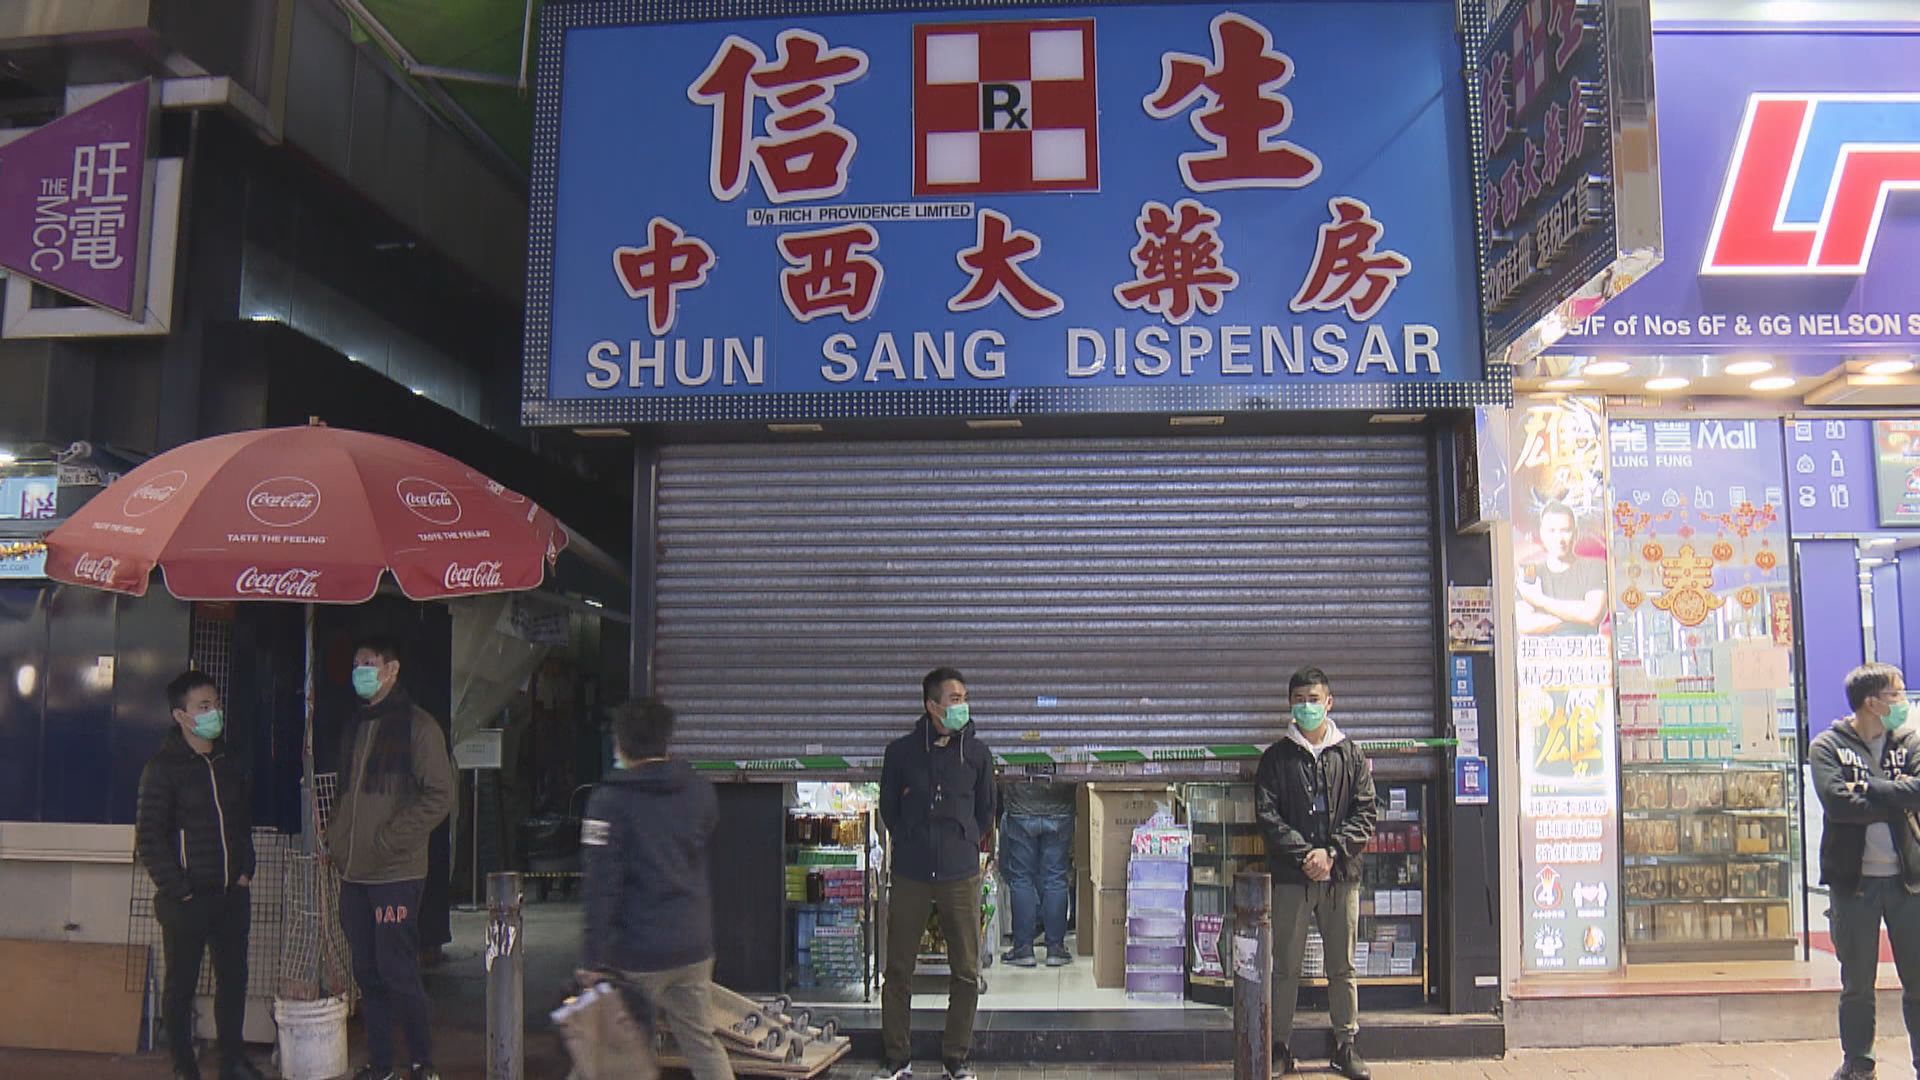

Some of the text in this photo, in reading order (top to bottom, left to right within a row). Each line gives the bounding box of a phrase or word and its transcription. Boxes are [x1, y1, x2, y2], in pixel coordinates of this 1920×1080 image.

[688, 12, 1322, 204] 信 生
[69, 142, 130, 269] 旺電
[779, 207, 812, 222] RICH
[819, 205, 910, 220] PROVIDENCE
[915, 204, 970, 218] LIMITED
[30, 178, 69, 272] THE MCC
[613, 197, 1412, 336] 中西大藥房
[1613, 315, 1638, 336] of
[1644, 315, 1691, 336] Nos
[1697, 315, 1727, 336] 6F
[1734, 315, 1753, 336] &
[1758, 315, 1792, 336] 6G
[1799, 313, 1901, 336] NELSON
[585, 323, 1442, 390] SHUN SANG DISPENSAR
[1697, 420, 1757, 450] Mall
[1612, 455, 1692, 467] LUNG FUNG
[227, 534, 326, 544] TASTE THE FEELING
[1151, 748, 1206, 760] CUSTOMS
